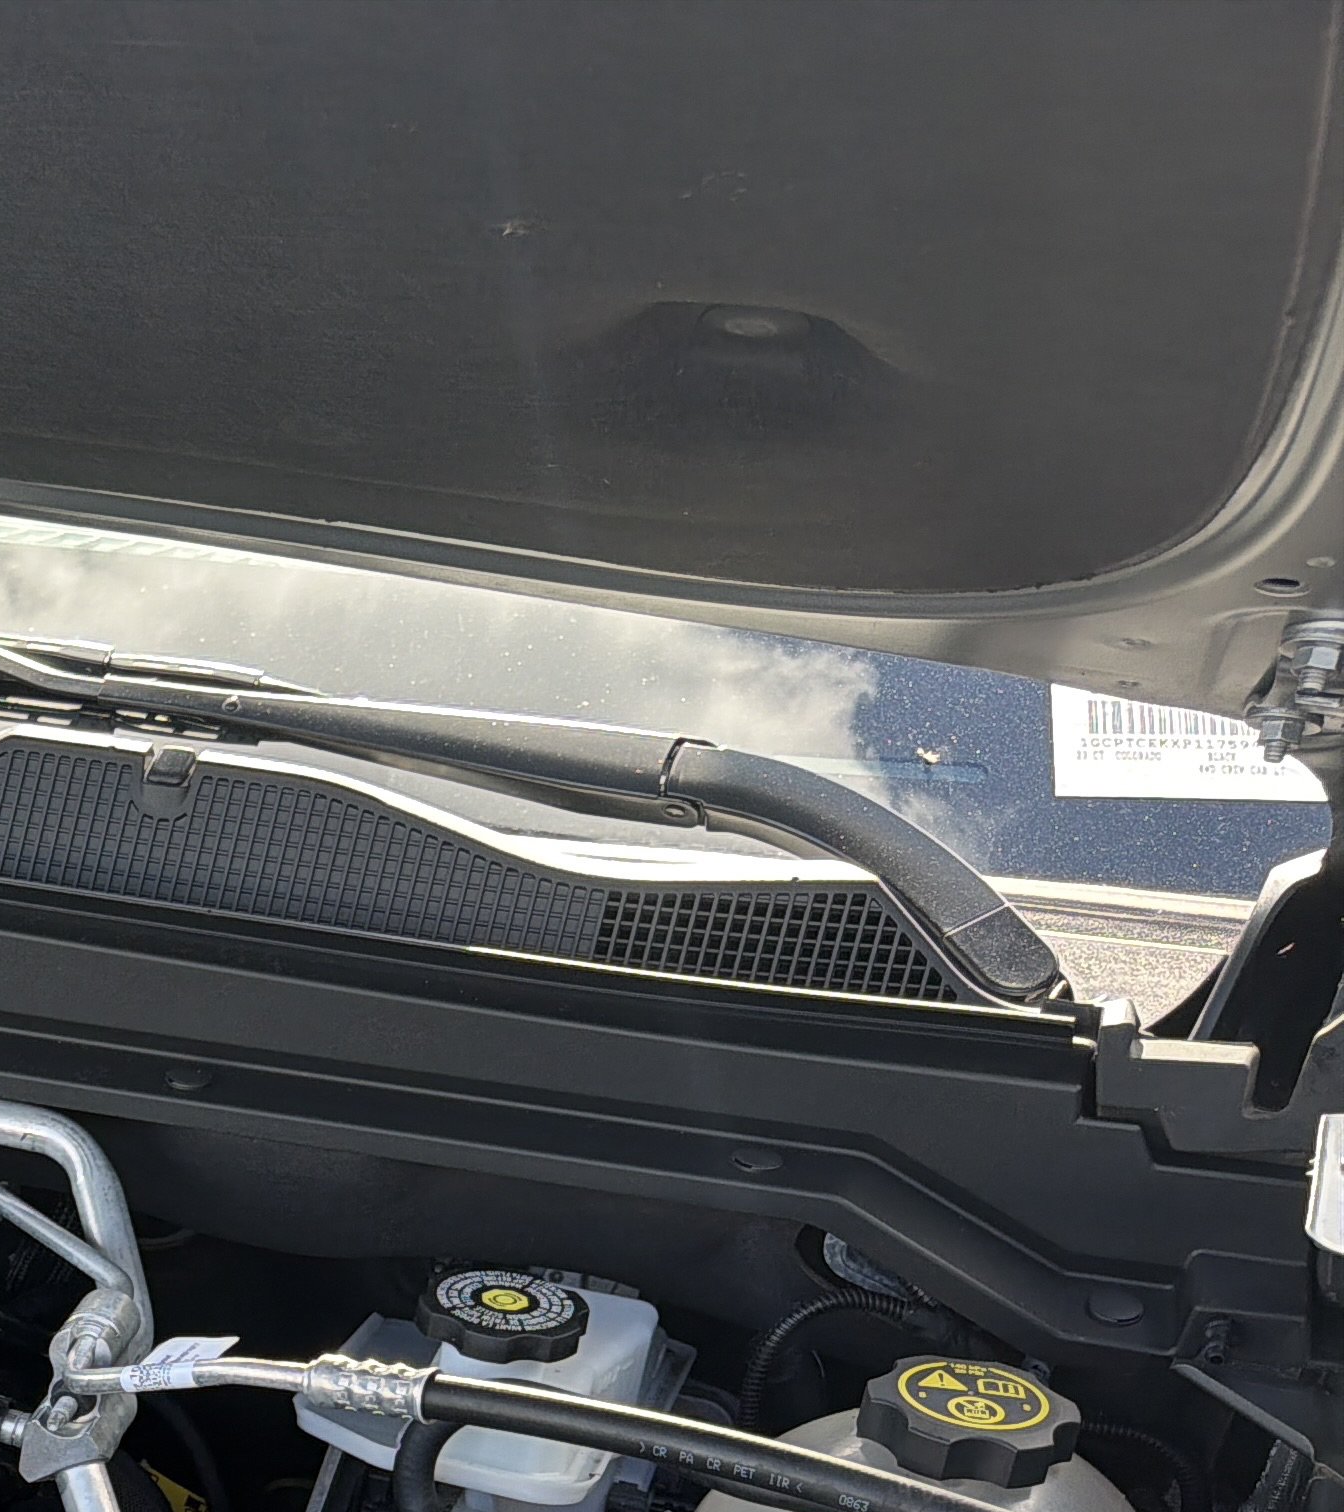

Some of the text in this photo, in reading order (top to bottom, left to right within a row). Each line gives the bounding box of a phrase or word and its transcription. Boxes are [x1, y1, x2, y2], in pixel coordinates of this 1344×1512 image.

[652, 1446, 668, 1459] CR
[679, 1452, 694, 1466] PA
[706, 1457, 721, 1471] CR
[733, 1464, 756, 1480] PET
[838, 1494, 869, 1512] 0863
